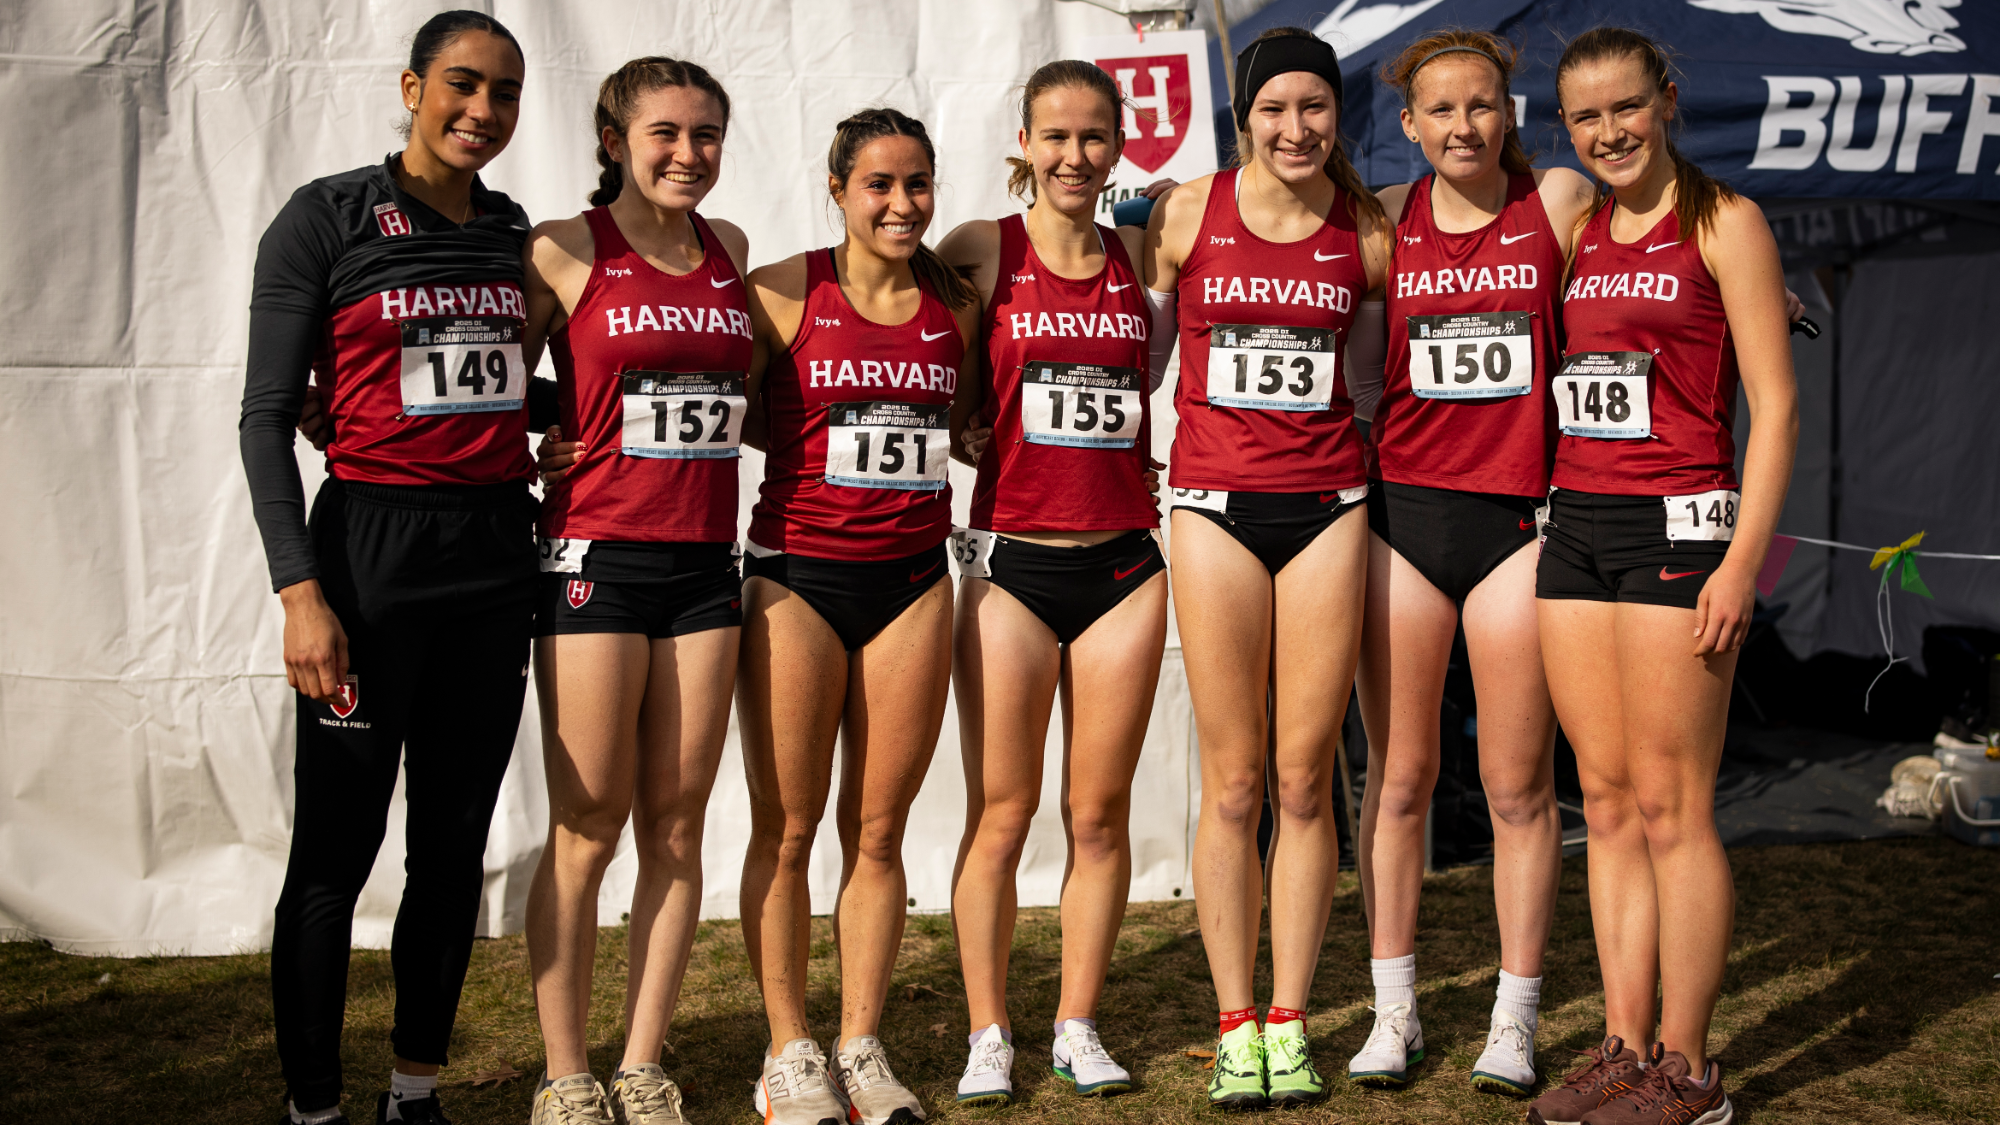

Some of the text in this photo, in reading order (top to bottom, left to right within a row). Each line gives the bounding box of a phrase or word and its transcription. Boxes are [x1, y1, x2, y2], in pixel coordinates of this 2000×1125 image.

[1115, 66, 1175, 139] H
[1747, 73, 2000, 175] BUFF
[383, 212, 407, 235] H
[1210, 236, 1226, 246] Ivy
[605, 268, 623, 278] Ivy
[1011, 274, 1027, 284] Ivy
[1397, 264, 1538, 299] HARVARD
[380, 286, 526, 320] HARVARD
[1203, 276, 1352, 314] HARVARD
[606, 304, 753, 341] HARVARD
[814, 316, 832, 328] Ivy
[1010, 312, 1146, 342] HARVARD
[1432, 326, 1501, 338] CHAMPIONSHIPS
[433, 332, 500, 343] CHAMPIONSHIPS
[1240, 338, 1308, 350] CHAMPIONSHIPS
[428, 350, 508, 397] 149
[810, 360, 956, 395] HARVARD
[1233, 354, 1314, 397] 153
[1428, 342, 1512, 384] 150
[1571, 366, 1622, 374] CHAMPIONSHIPS
[656, 384, 719, 394] CHAMPIONSHIPS
[1055, 375, 1118, 388] CHAMPIONSHIPS
[1049, 390, 1125, 433] 155
[1567, 381, 1631, 423] 148
[651, 400, 731, 443] 152
[860, 415, 925, 426] CHAMPIONSHIPS
[855, 432, 926, 474] 151
[1685, 500, 1734, 528] 148
[570, 580, 586, 600] H
[319, 718, 341, 727] TRACK
